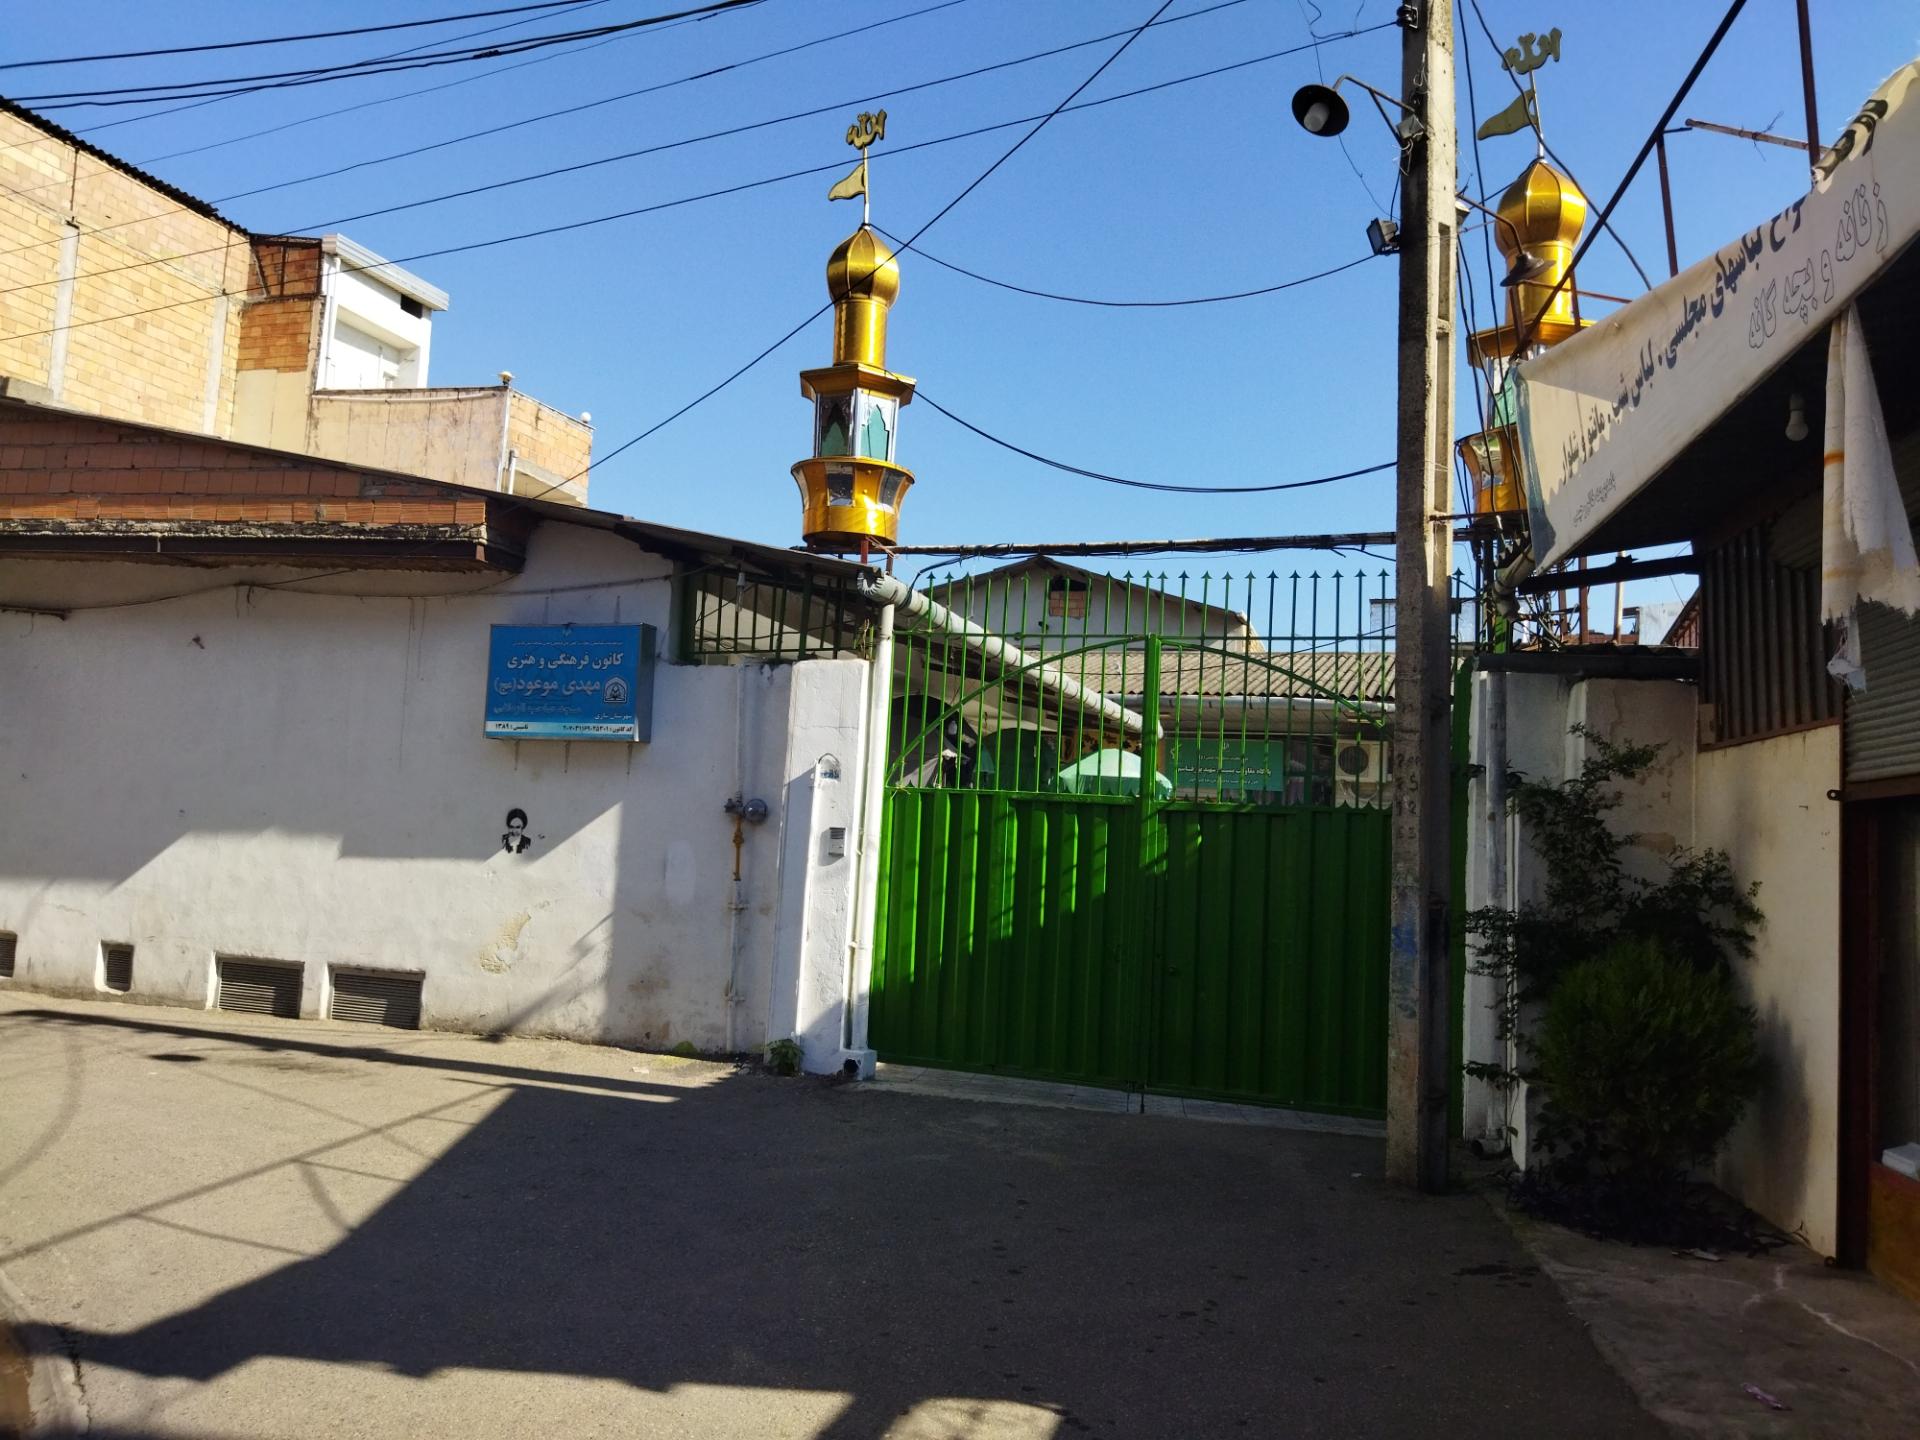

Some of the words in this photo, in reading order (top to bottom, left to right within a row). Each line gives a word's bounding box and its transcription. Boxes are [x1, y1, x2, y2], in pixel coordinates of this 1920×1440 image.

[1836, 183, 1889, 262] زنانه
[1820, 249, 1835, 304] و
[1666, 293, 1706, 369] مجلسی
[1631, 338, 1655, 408] لباس
[1612, 372, 1629, 425] شب
[506, 654, 536, 669] هنری
[538, 656, 546, 669] و
[547, 651, 590, 670] فرهنگی
[591, 651, 624, 670] کانون
[561, 679, 601, 696] مهدی
